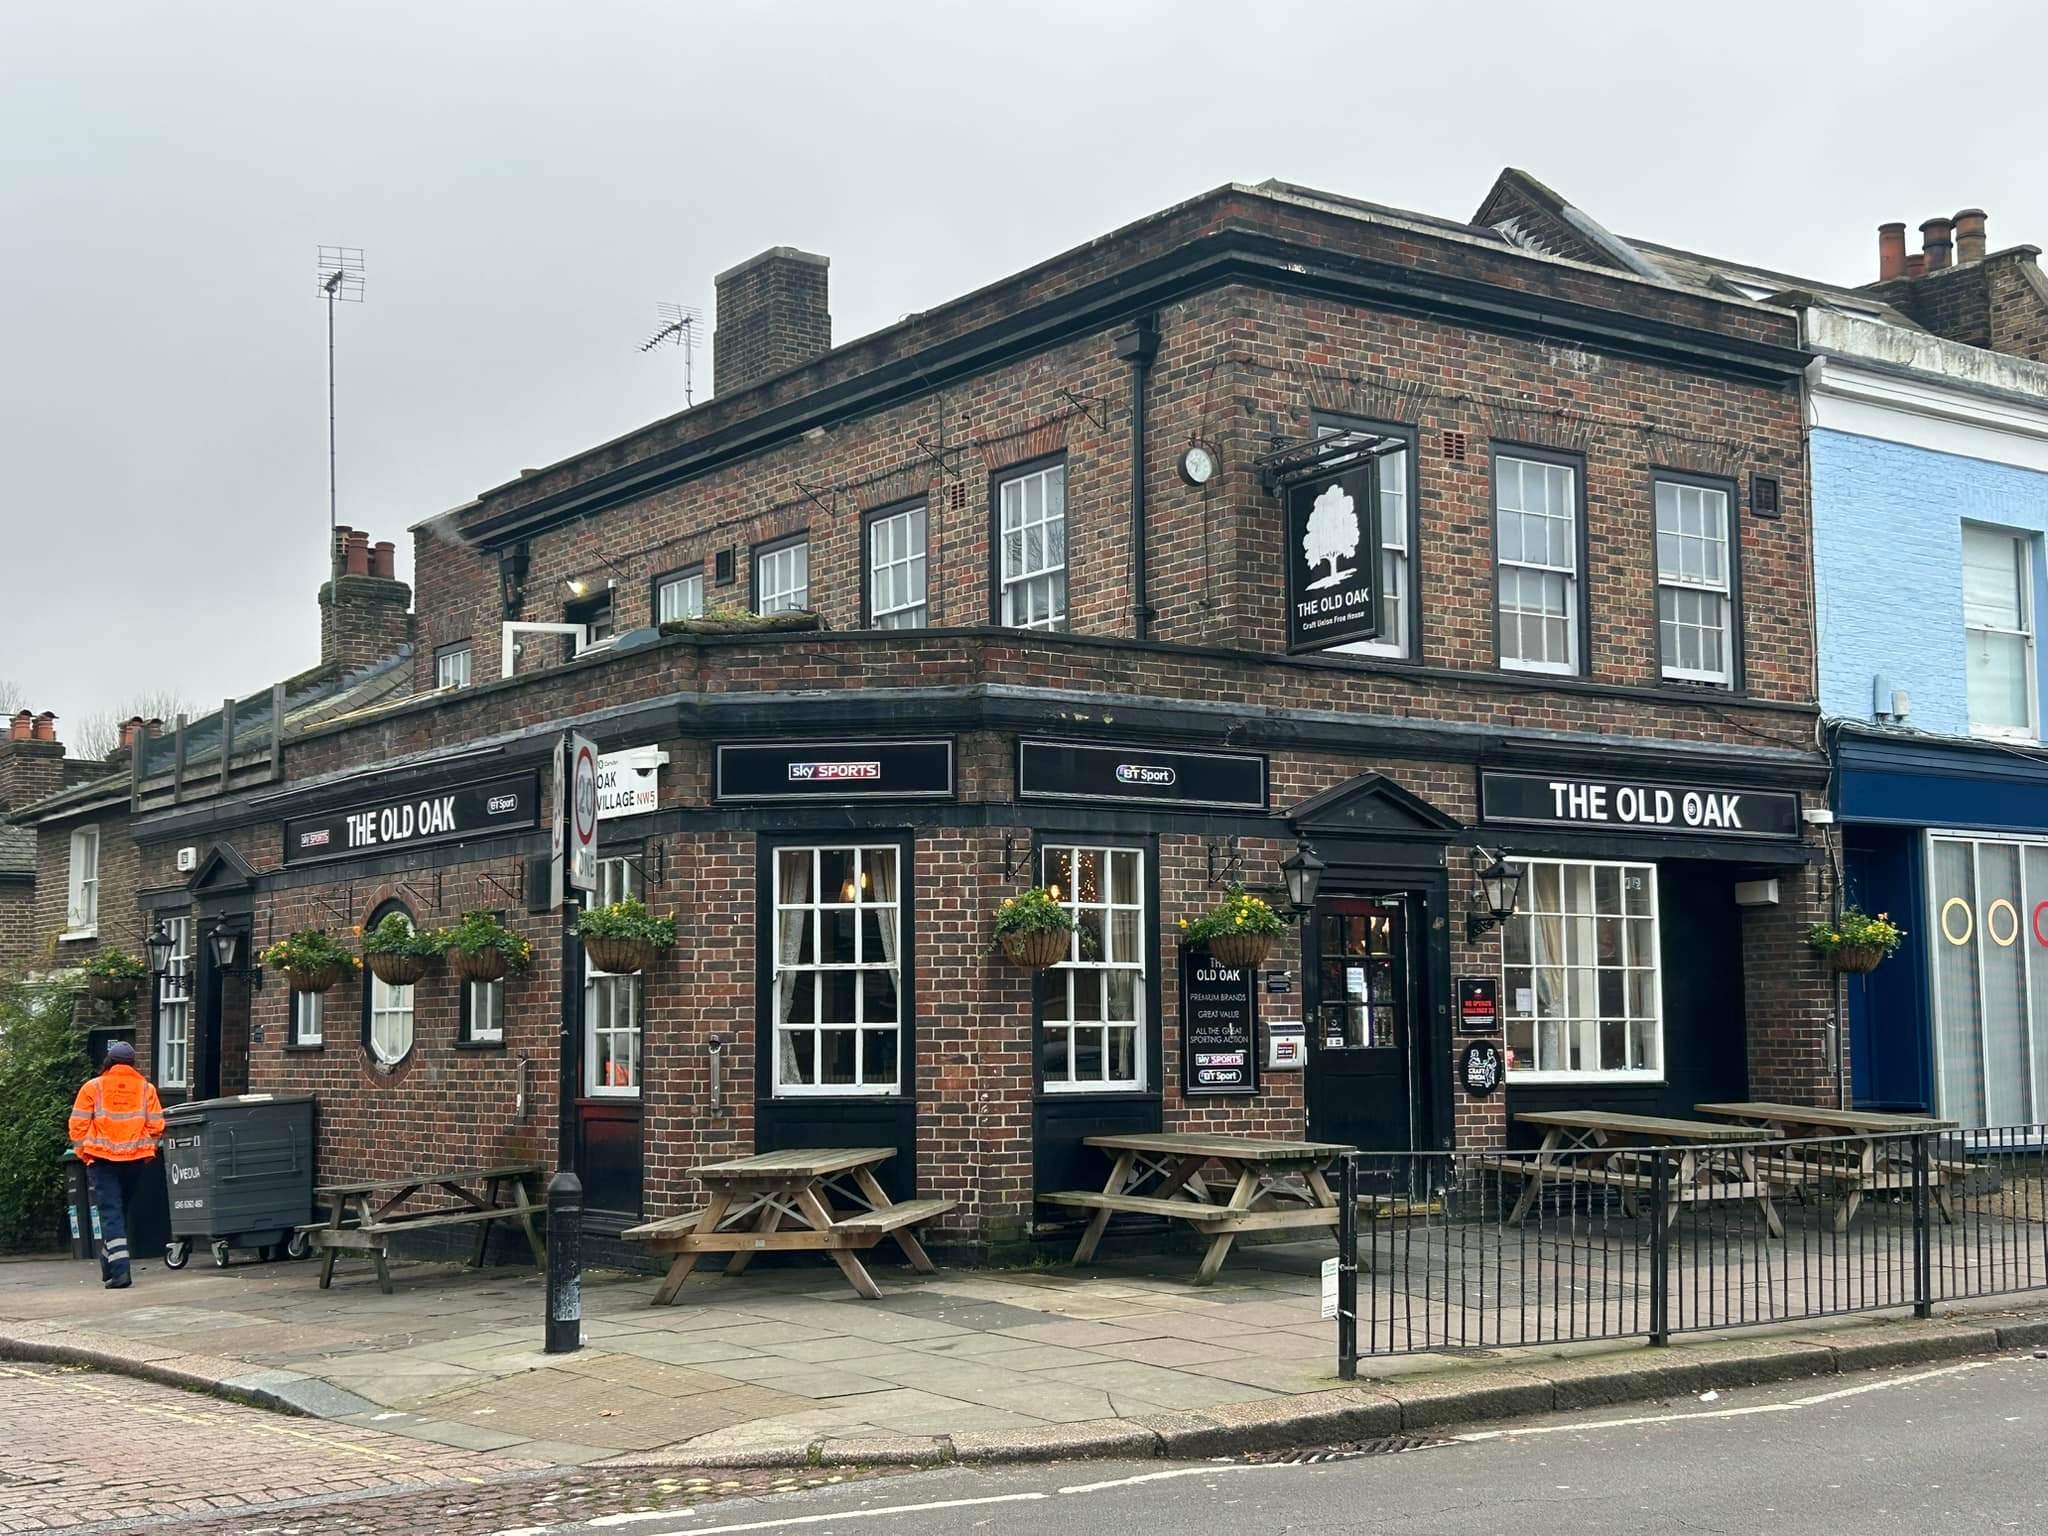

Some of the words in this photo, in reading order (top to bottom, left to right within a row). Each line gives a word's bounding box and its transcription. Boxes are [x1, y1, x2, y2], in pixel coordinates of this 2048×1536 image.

[1297, 599, 1318, 618] THE
[1320, 595, 1343, 613] OLD
[1345, 587, 1369, 605] OAK
[1302, 620, 1316, 631] Craft
[1317, 616, 1333, 628] Union
[1334, 614, 1346, 625] Free
[792, 764, 815, 778] sky
[818, 764, 877, 777] SPORTS
[1123, 767, 1140, 779] BT
[1140, 769, 1169, 782] Sport
[597, 771, 616, 789] OAK
[578, 775, 593, 817] 20
[597, 790, 635, 811] VILLAGE
[636, 790, 655, 805] NW5
[499, 797, 515, 811] Sport
[1549, 782, 1608, 821] THE
[1616, 786, 1674, 825] OLD
[1682, 791, 1743, 829] OAK
[346, 811, 377, 848] THE
[381, 804, 414, 843] OLD
[418, 795, 456, 836] OAK
[1210, 957, 1226, 969] TH
[1196, 969, 1217, 982] OLD
[1219, 969, 1241, 982] OAK
[1190, 993, 1220, 1002] PREMIUM
[1220, 993, 1247, 1002] BRANDS
[1197, 1010, 1219, 1019] GREAT
[1220, 1010, 1240, 1019] VALUE
[1195, 1027, 1208, 1035] ALL
[1208, 1027, 1220, 1035] THE
[1190, 1035, 1223, 1044] SPORTING
[1223, 1035, 1249, 1044] ACTION
[1211, 1054, 1242, 1064] SPORTS
[1216, 1071, 1237, 1083] Sport
